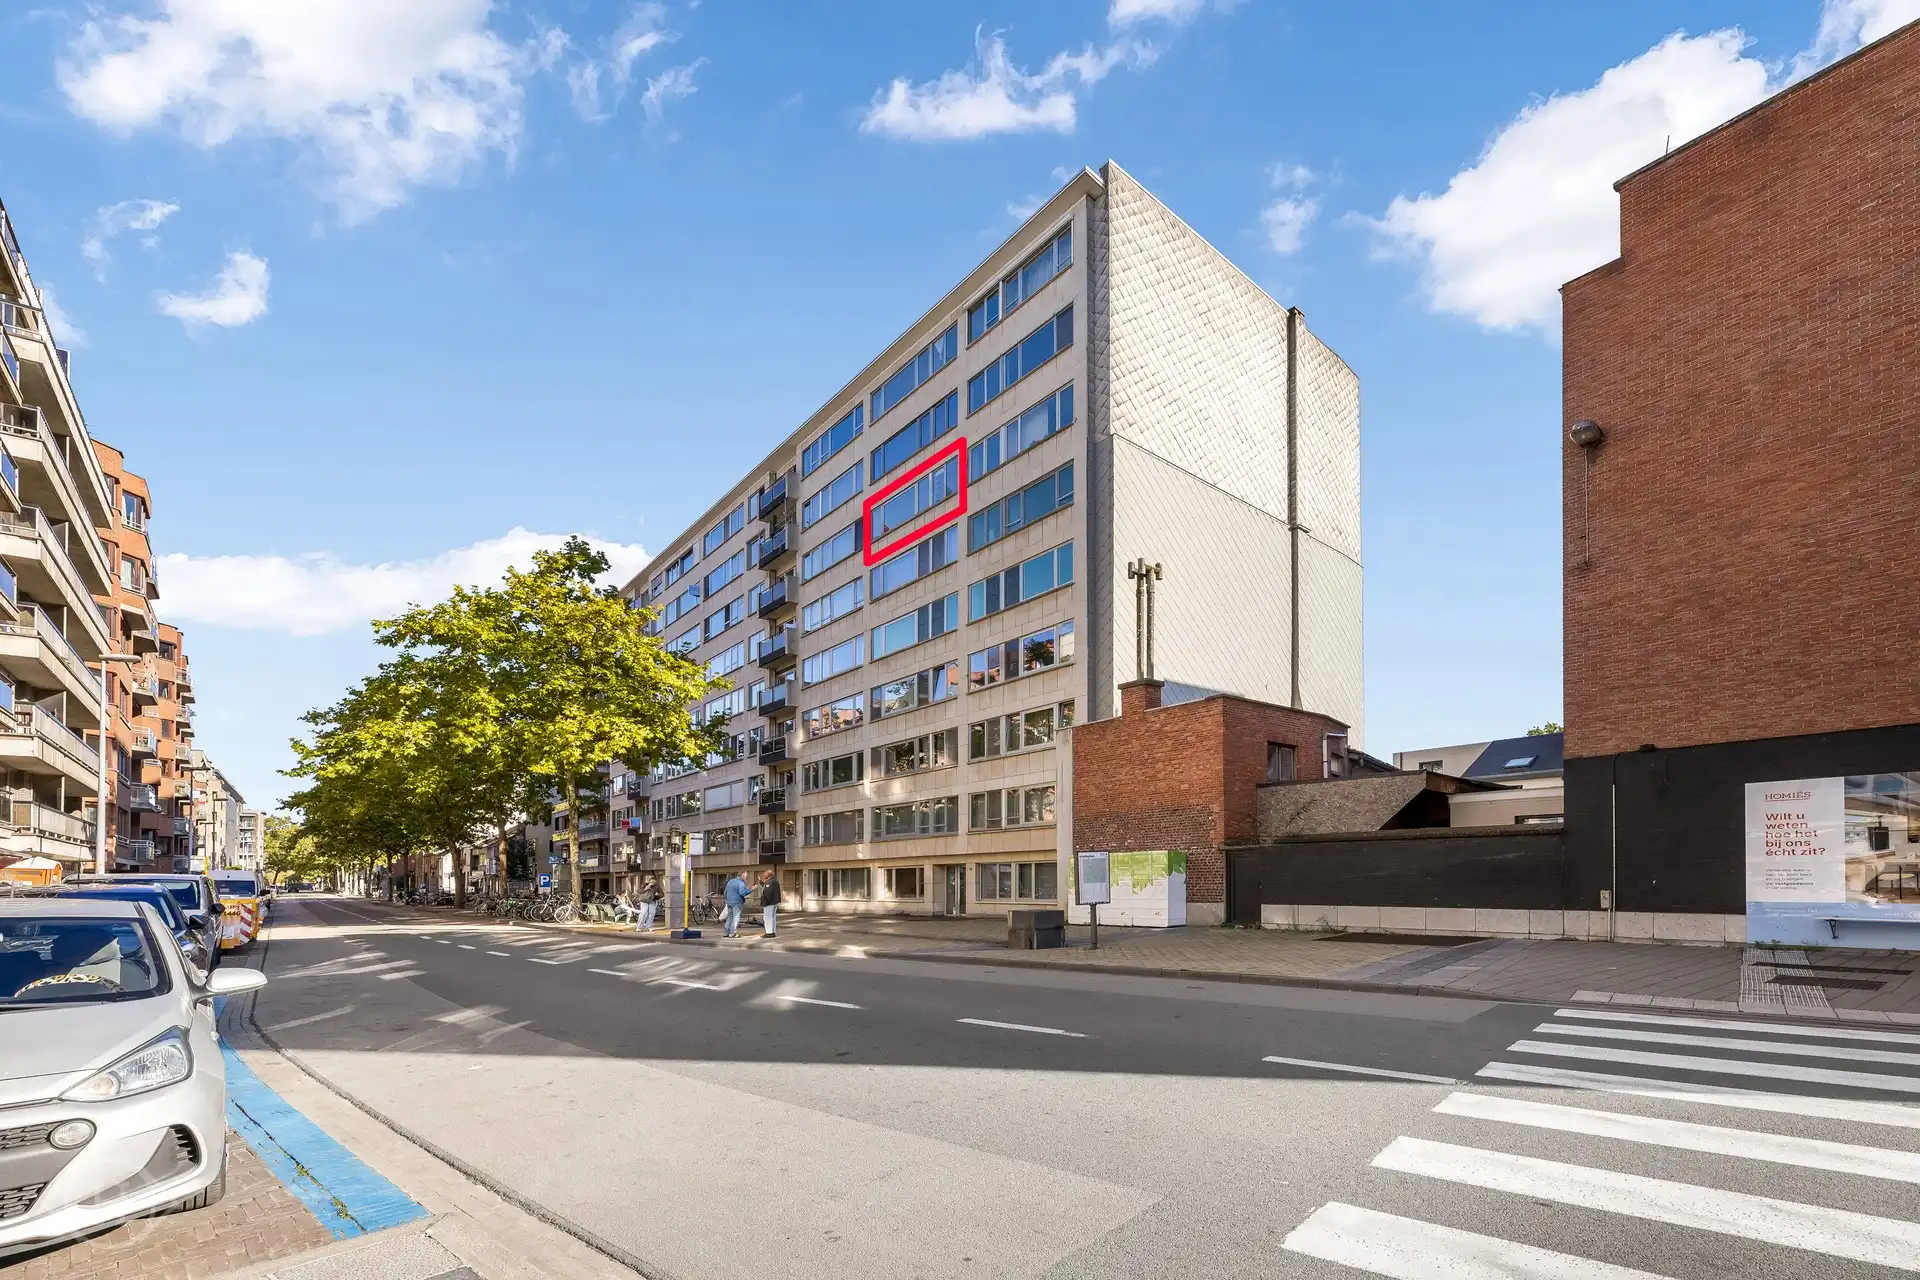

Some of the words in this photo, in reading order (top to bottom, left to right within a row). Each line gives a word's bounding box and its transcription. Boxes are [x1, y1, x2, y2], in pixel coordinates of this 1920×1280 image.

[1795, 830, 1818, 838] het
[1765, 840, 1781, 848] bij
[1765, 848, 1796, 856] écht
[1800, 847, 1826, 856] zit?
[540, 876, 550, 886] P
